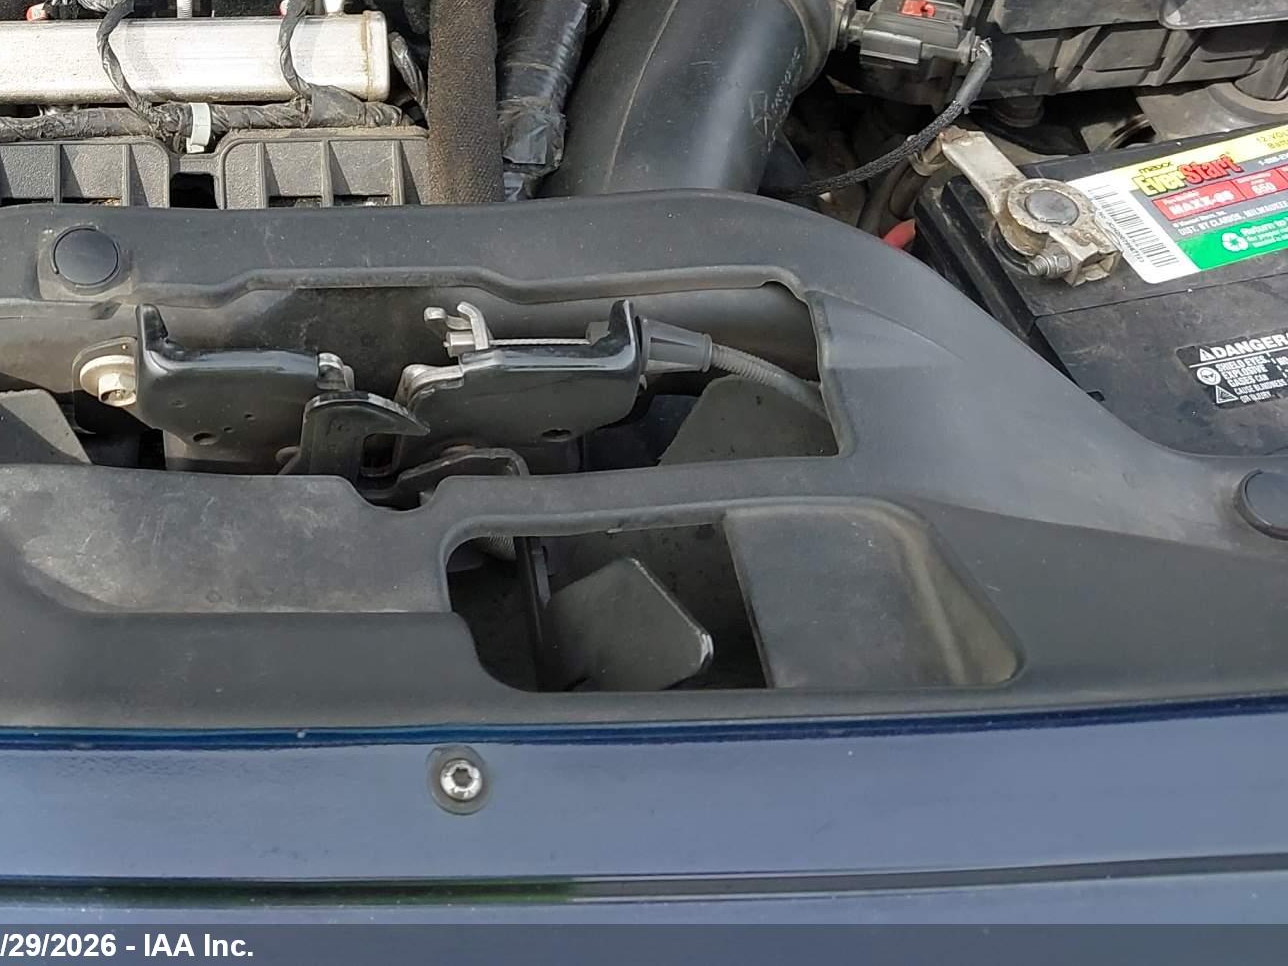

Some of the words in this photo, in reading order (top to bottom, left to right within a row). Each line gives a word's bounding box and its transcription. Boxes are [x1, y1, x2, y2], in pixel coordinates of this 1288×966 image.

[1139, 161, 1172, 173] maxx
[1132, 154, 1244, 197] EverStart
[1221, 364, 1269, 380] EXPLOSIVE
